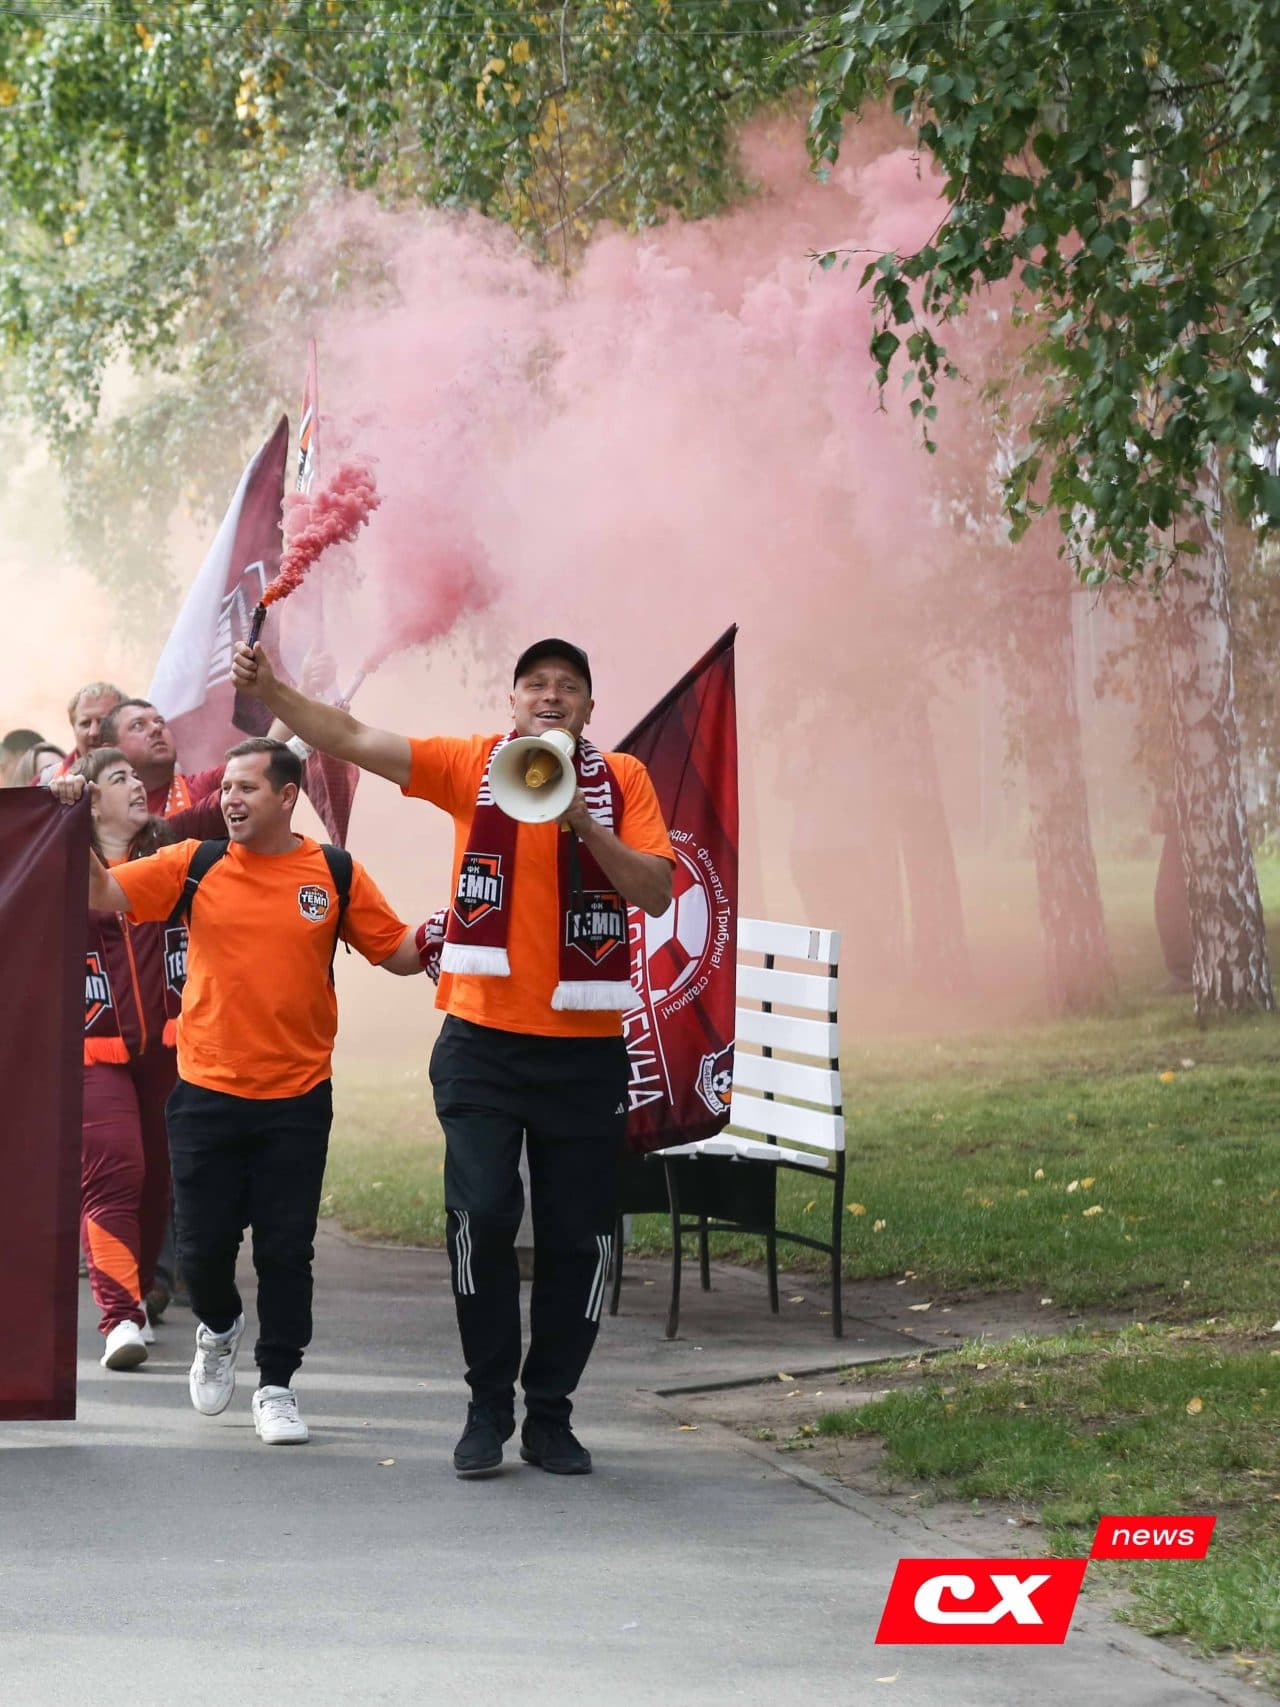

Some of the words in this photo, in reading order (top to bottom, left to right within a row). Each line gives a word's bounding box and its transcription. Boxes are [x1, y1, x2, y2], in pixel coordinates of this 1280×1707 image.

[577, 781, 614, 835] ТЕМ
[301, 894, 327, 906] ТЕМП
[458, 874, 497, 902] ЕМП
[697, 847, 729, 904] фанаты!
[710, 906, 731, 969] Трибуна!
[661, 976, 709, 1020] стадион!
